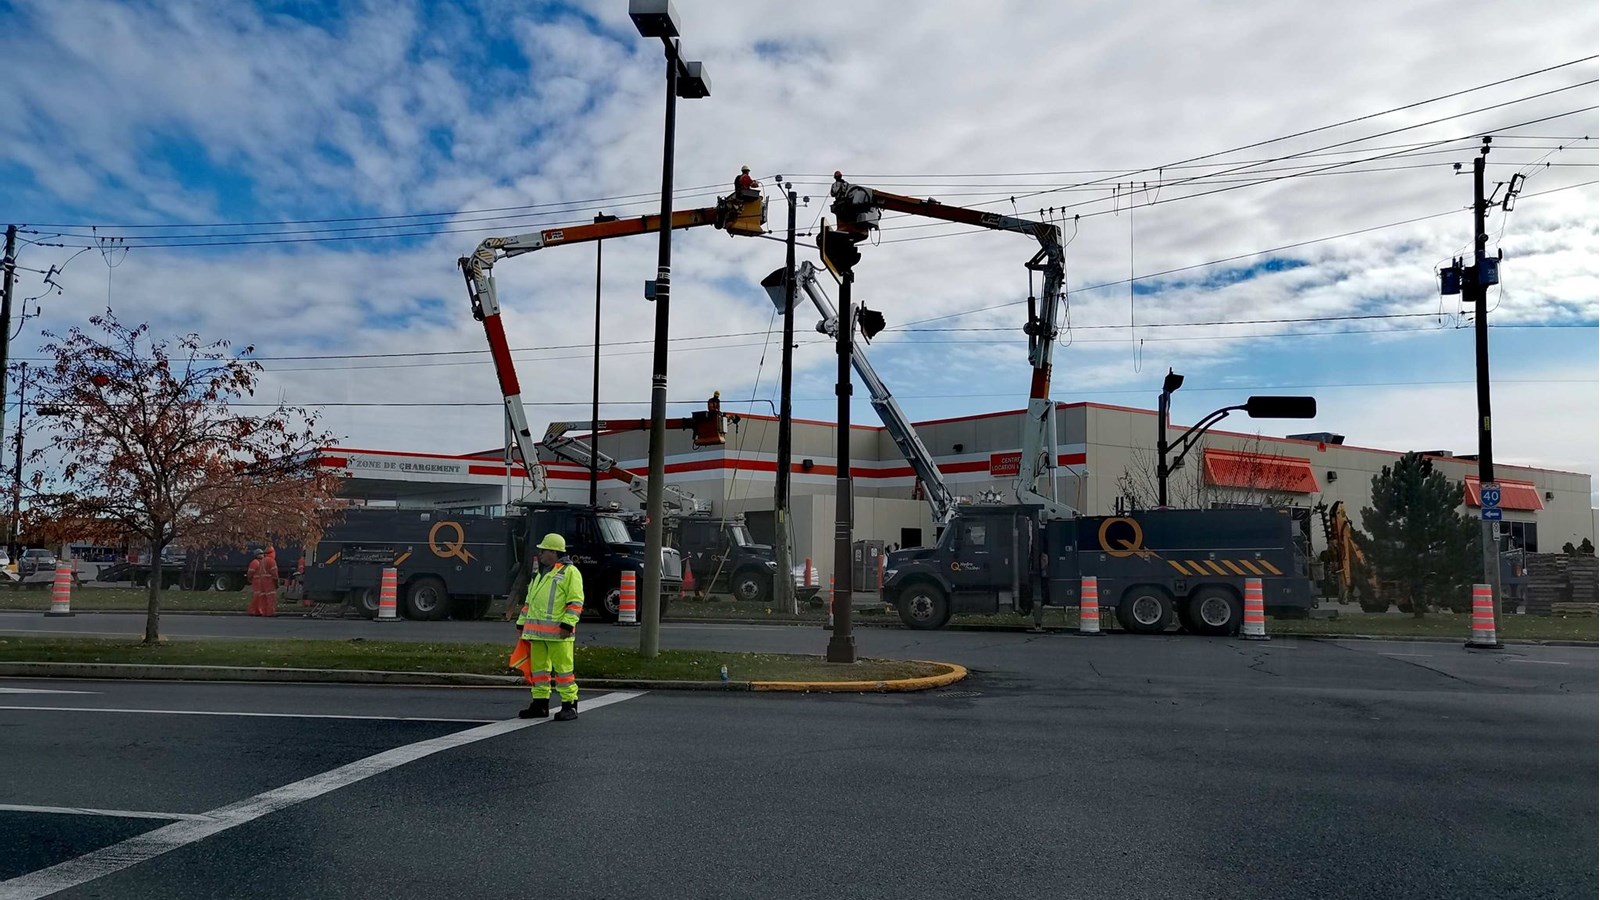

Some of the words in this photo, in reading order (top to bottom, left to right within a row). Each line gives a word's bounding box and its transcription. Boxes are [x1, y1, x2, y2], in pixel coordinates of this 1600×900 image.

[356, 460, 381, 469] ZONE
[384, 461, 396, 469] DE
[398, 462, 461, 473] CHARGEMENT
[991, 463, 1016, 471] LOCATION
[1483, 491, 1499, 501] 40
